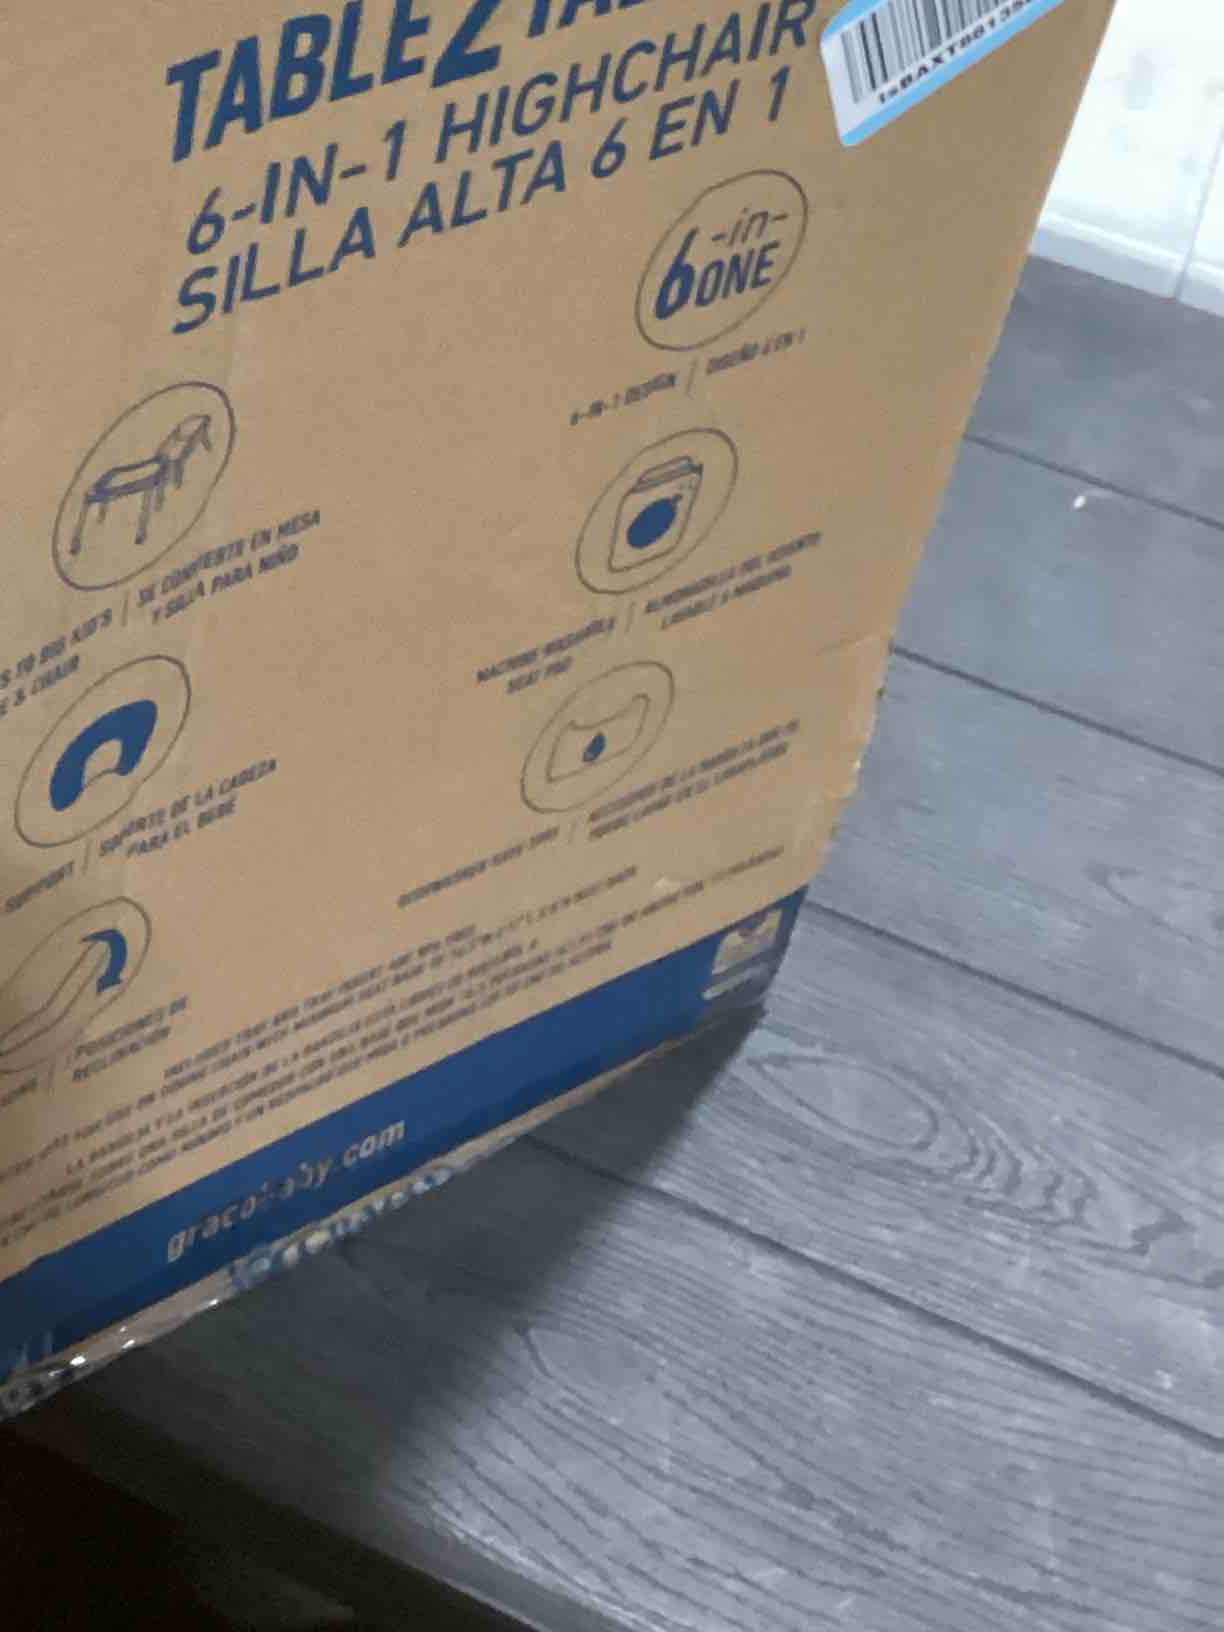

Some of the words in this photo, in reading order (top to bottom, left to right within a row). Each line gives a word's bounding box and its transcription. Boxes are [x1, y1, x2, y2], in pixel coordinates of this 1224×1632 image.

[171, 205, 376, 335] SILLA
[396, 139, 567, 249] ALTA
[590, 117, 629, 179] 6
[648, 78, 741, 161] EN
[766, 64, 791, 123] 1
[187, 118, 409, 256] 6-IN-1
[653, 226, 699, 320] 6
[694, 240, 780, 307] ONE
[210, 560, 254, 597] PARA
